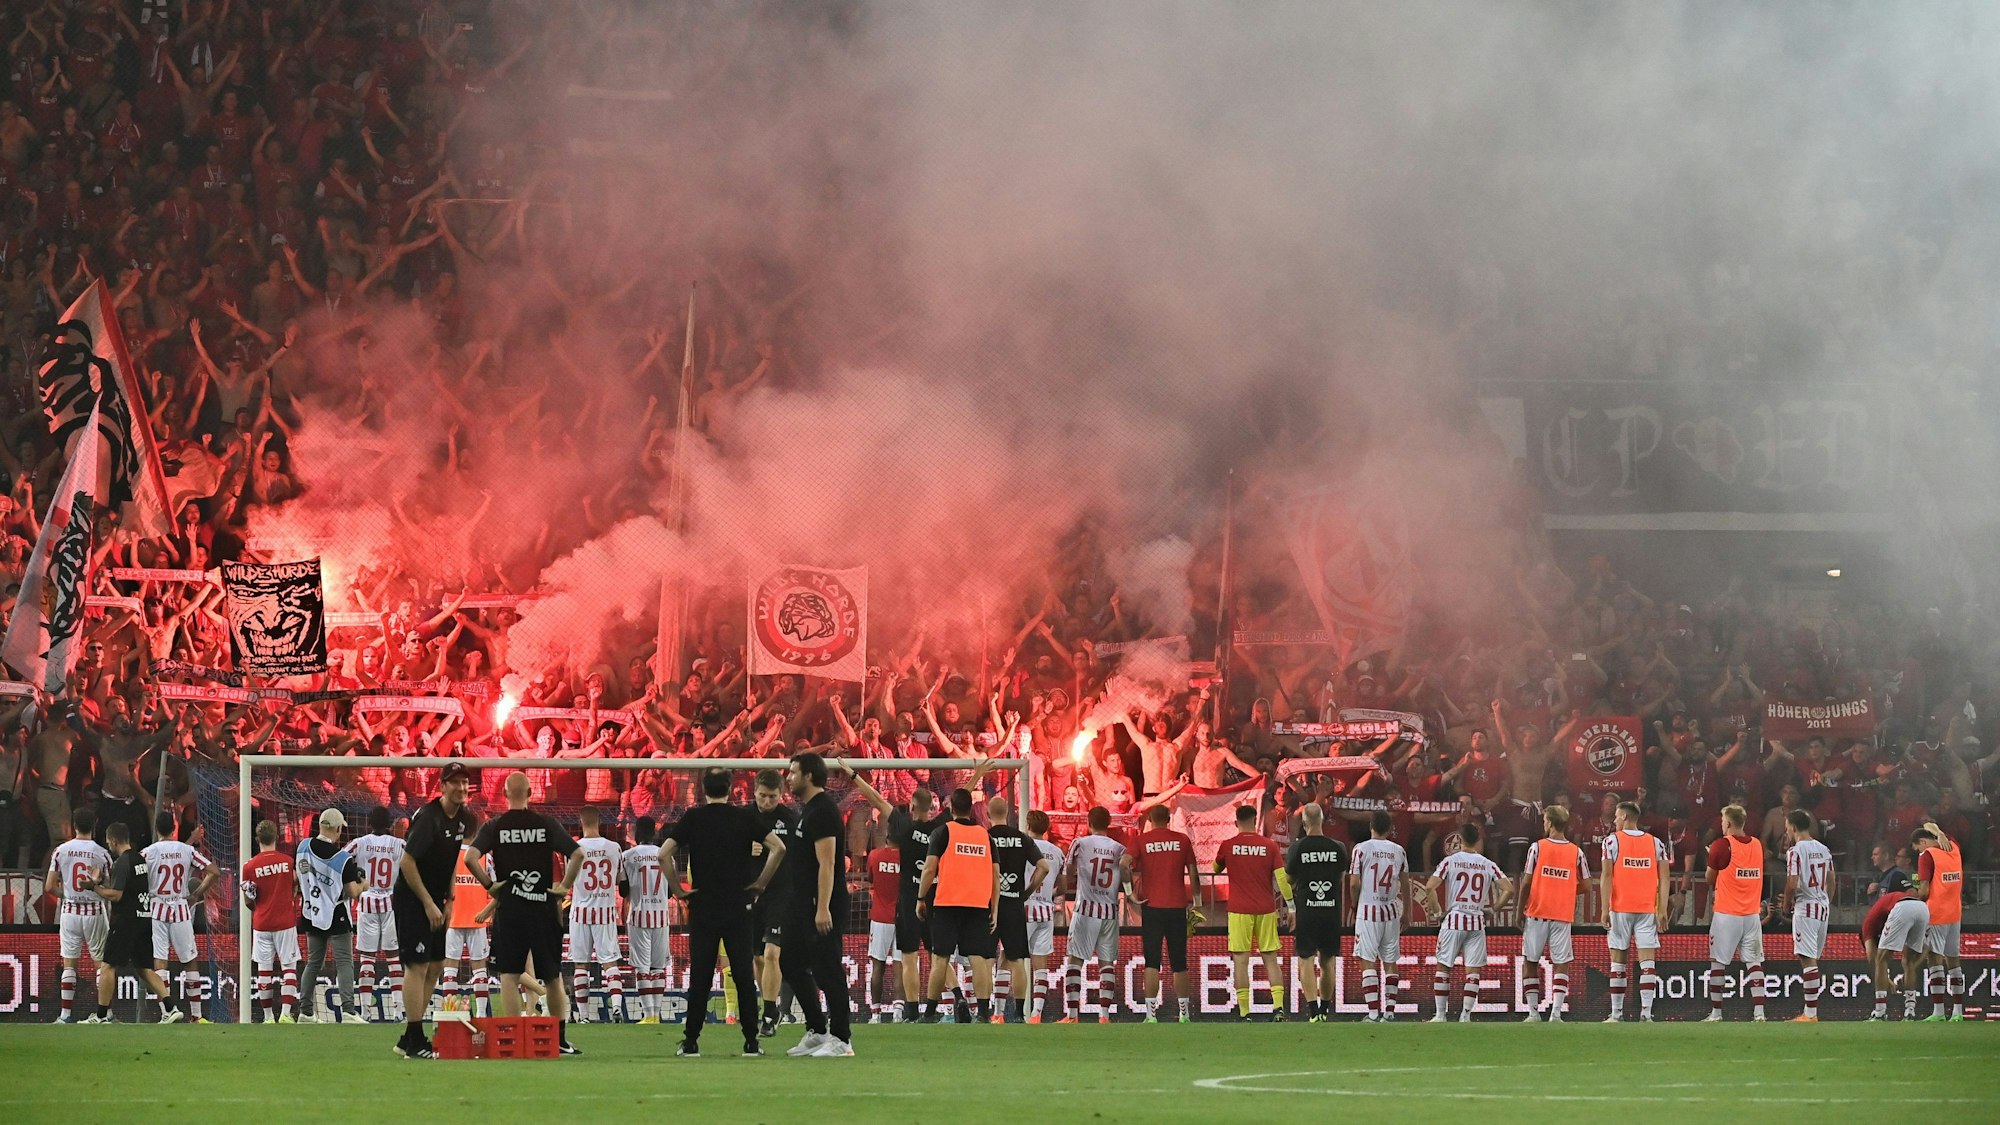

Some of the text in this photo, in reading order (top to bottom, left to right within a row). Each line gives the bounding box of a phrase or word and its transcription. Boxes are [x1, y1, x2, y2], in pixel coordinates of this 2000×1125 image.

[226, 561, 320, 583] WILDE HORDE
[758, 571, 856, 639] WILDE HORDE
[781, 647, 832, 664] 1996
[1768, 699, 1869, 719] HÖHER JUNGS
[1346, 720, 1400, 735] KÖLN
[1807, 720, 1832, 729] 2013
[1575, 723, 1638, 754] SAUERLAND
[500, 828, 547, 844] REWE
[911, 829, 931, 845] RE
[1592, 835, 1604, 844] RE
[586, 849, 607, 858] DIETZ
[957, 844, 985, 856] REWE
[1093, 847, 1115, 857] KILIAN
[1145, 841, 1181, 853] REWE
[1232, 845, 1267, 857] REWE
[68, 850, 95, 859] MARTEL
[160, 852, 182, 860] SKHIRI
[633, 855, 659, 863] SCHIND
[1301, 851, 1338, 863] REWE
[1372, 850, 1395, 860] HECTOR
[1454, 861, 1486, 871] THIELMANN
[1624, 858, 1650, 867] REWE
[255, 862, 290, 878] REWE
[367, 856, 393, 889] 19
[582, 858, 613, 891] 33
[1089, 857, 1114, 889] 15
[1542, 867, 1569, 878] REWE
[1737, 869, 1760, 878] REWE
[72, 861, 87, 893] 6
[157, 863, 185, 895] 28
[456, 876, 481, 884] REWE
[639, 864, 663, 896] 17
[1370, 862, 1394, 895] 14
[1808, 862, 1826, 894] 47
[1943, 872, 1961, 882] REWE
[511, 884, 548, 902] hummel
[1455, 871, 1485, 904] 29
[1306, 898, 1336, 907] hummel
